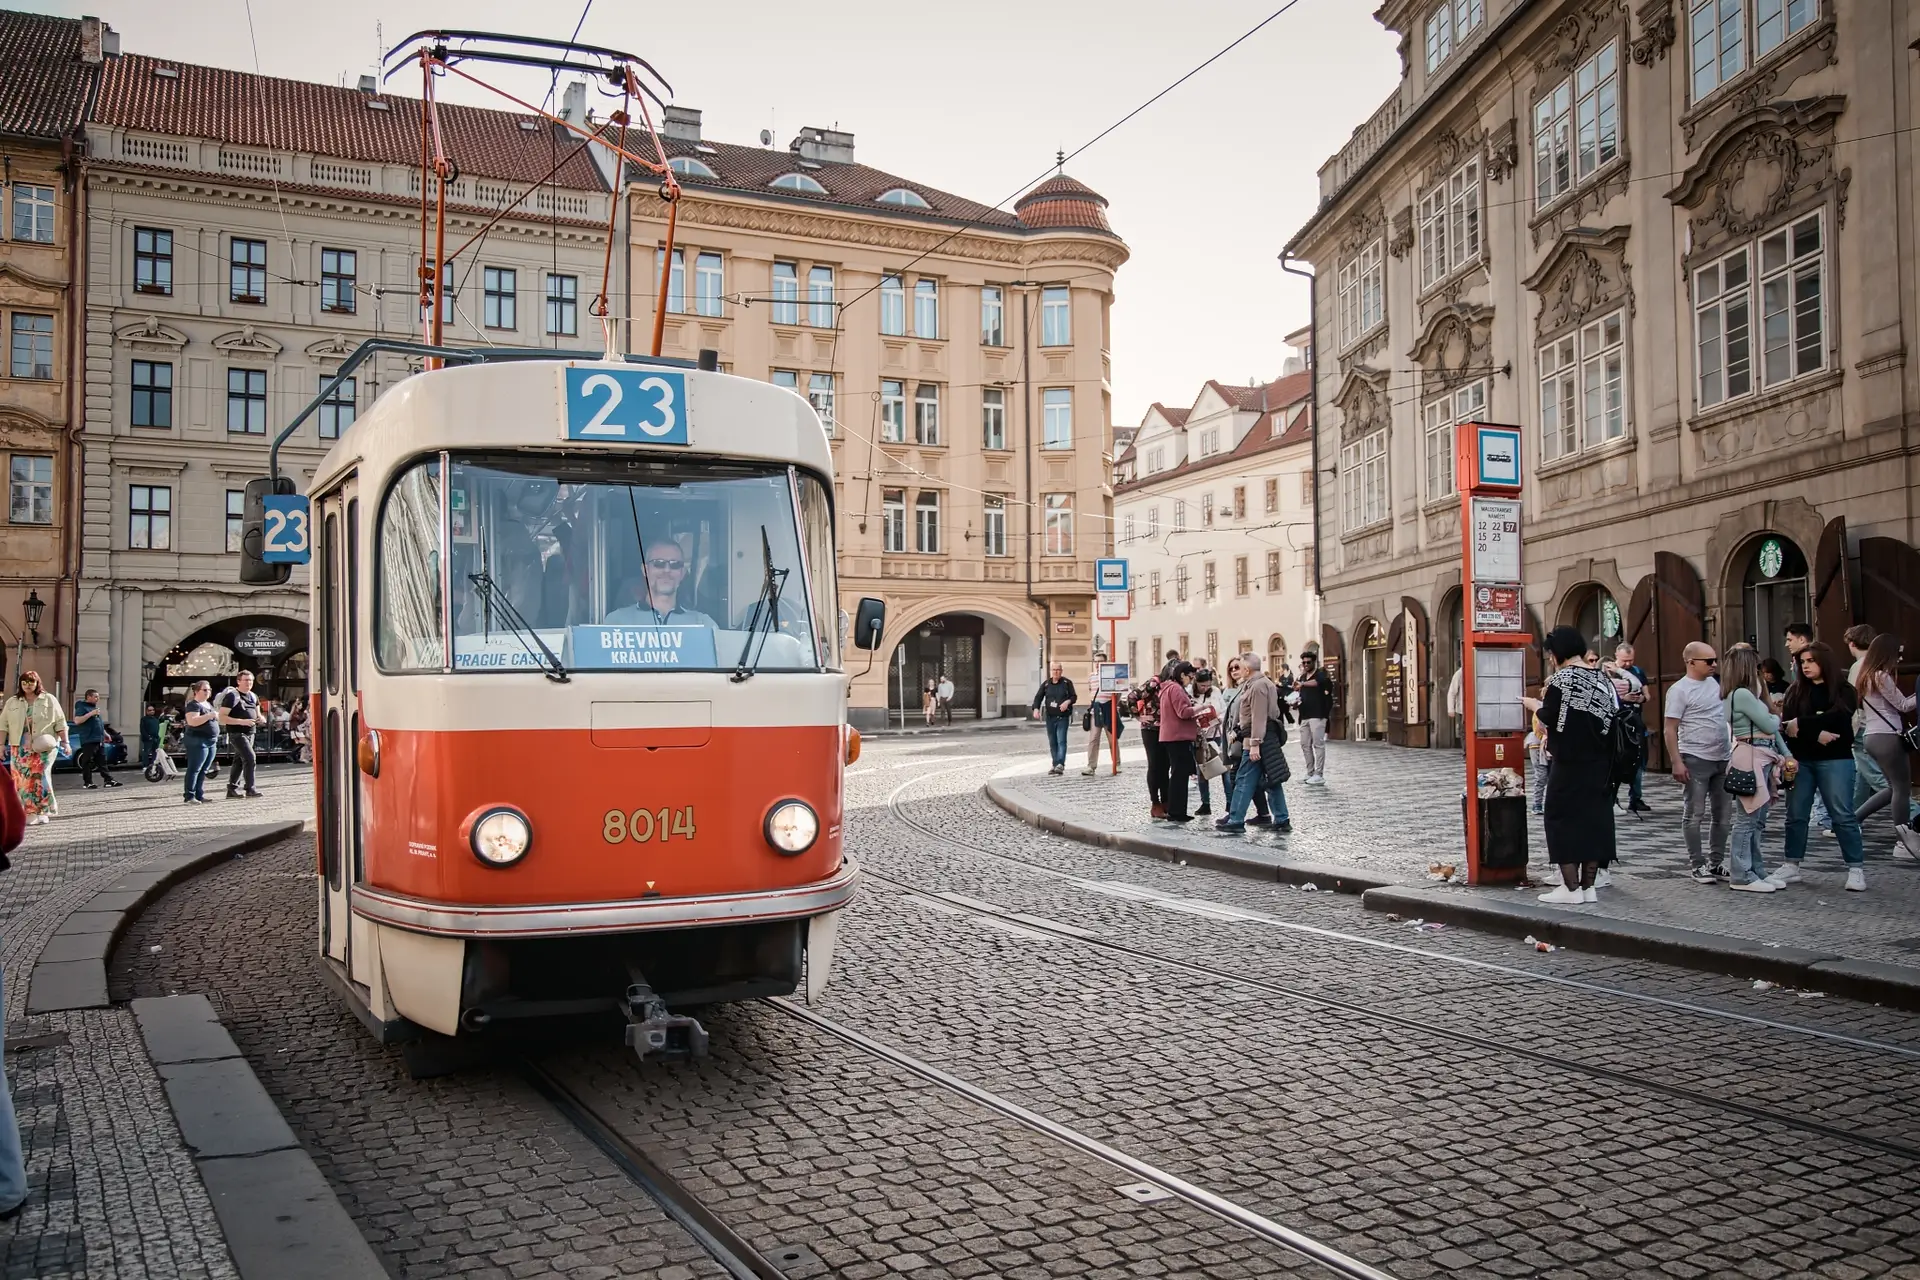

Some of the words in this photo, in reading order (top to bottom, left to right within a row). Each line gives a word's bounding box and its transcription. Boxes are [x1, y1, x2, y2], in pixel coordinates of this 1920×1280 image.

[580, 373, 676, 436] 23
[264, 509, 308, 552] 23
[1478, 521, 1487, 530] 12
[1492, 522, 1501, 531] 22
[1505, 522, 1515, 532] 97
[1478, 532, 1487, 541] 15
[1492, 533, 1501, 542] 23
[1477, 543, 1487, 552] 20
[601, 629, 683, 649] BŘEVNOV
[455, 653, 507, 667] PRAGUE
[611, 649, 679, 664] KRÁLOVKA
[1408, 621, 1416, 718] ANTIQUE
[602, 804, 697, 845] 8014
